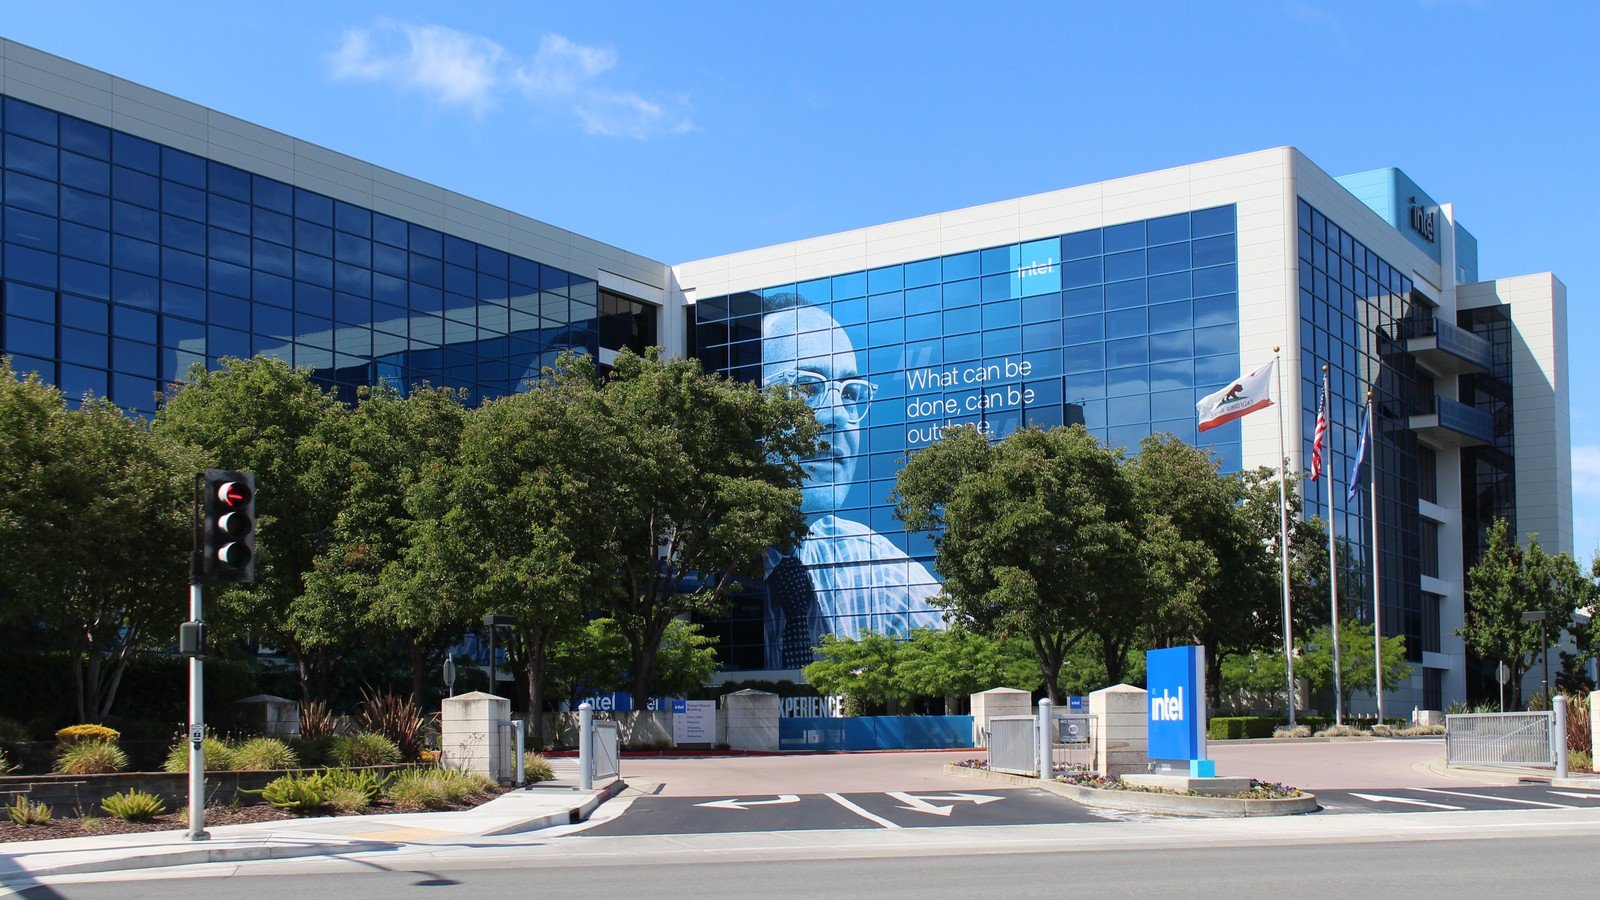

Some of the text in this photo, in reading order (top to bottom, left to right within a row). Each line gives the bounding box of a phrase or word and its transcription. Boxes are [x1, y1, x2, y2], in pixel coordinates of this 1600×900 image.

[1409, 196, 1434, 243] intel
[1017, 257, 1053, 279] intel
[906, 357, 1032, 391] What can be
[907, 385, 1035, 418] done, can be
[1151, 685, 1184, 721] intel
